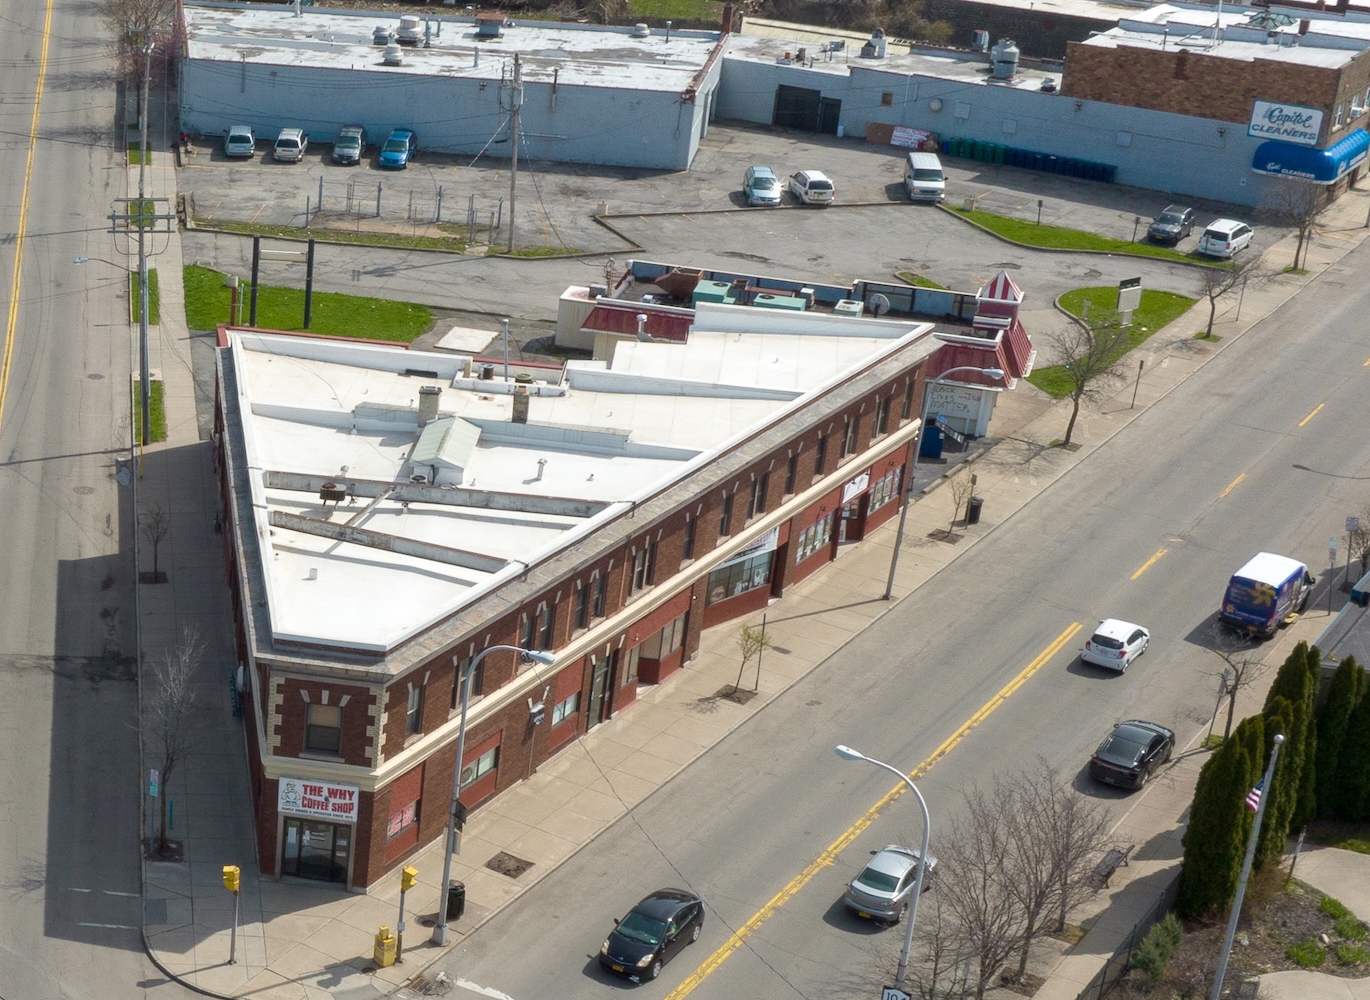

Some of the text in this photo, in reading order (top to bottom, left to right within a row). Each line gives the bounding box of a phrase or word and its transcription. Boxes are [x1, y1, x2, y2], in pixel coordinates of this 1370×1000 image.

[1266, 107, 1313, 128] Capitol
[1251, 124, 1316, 140] CLEANERS
[302, 784, 355, 800] THE WHY
[301, 796, 354, 814] COFFEE SHOP
